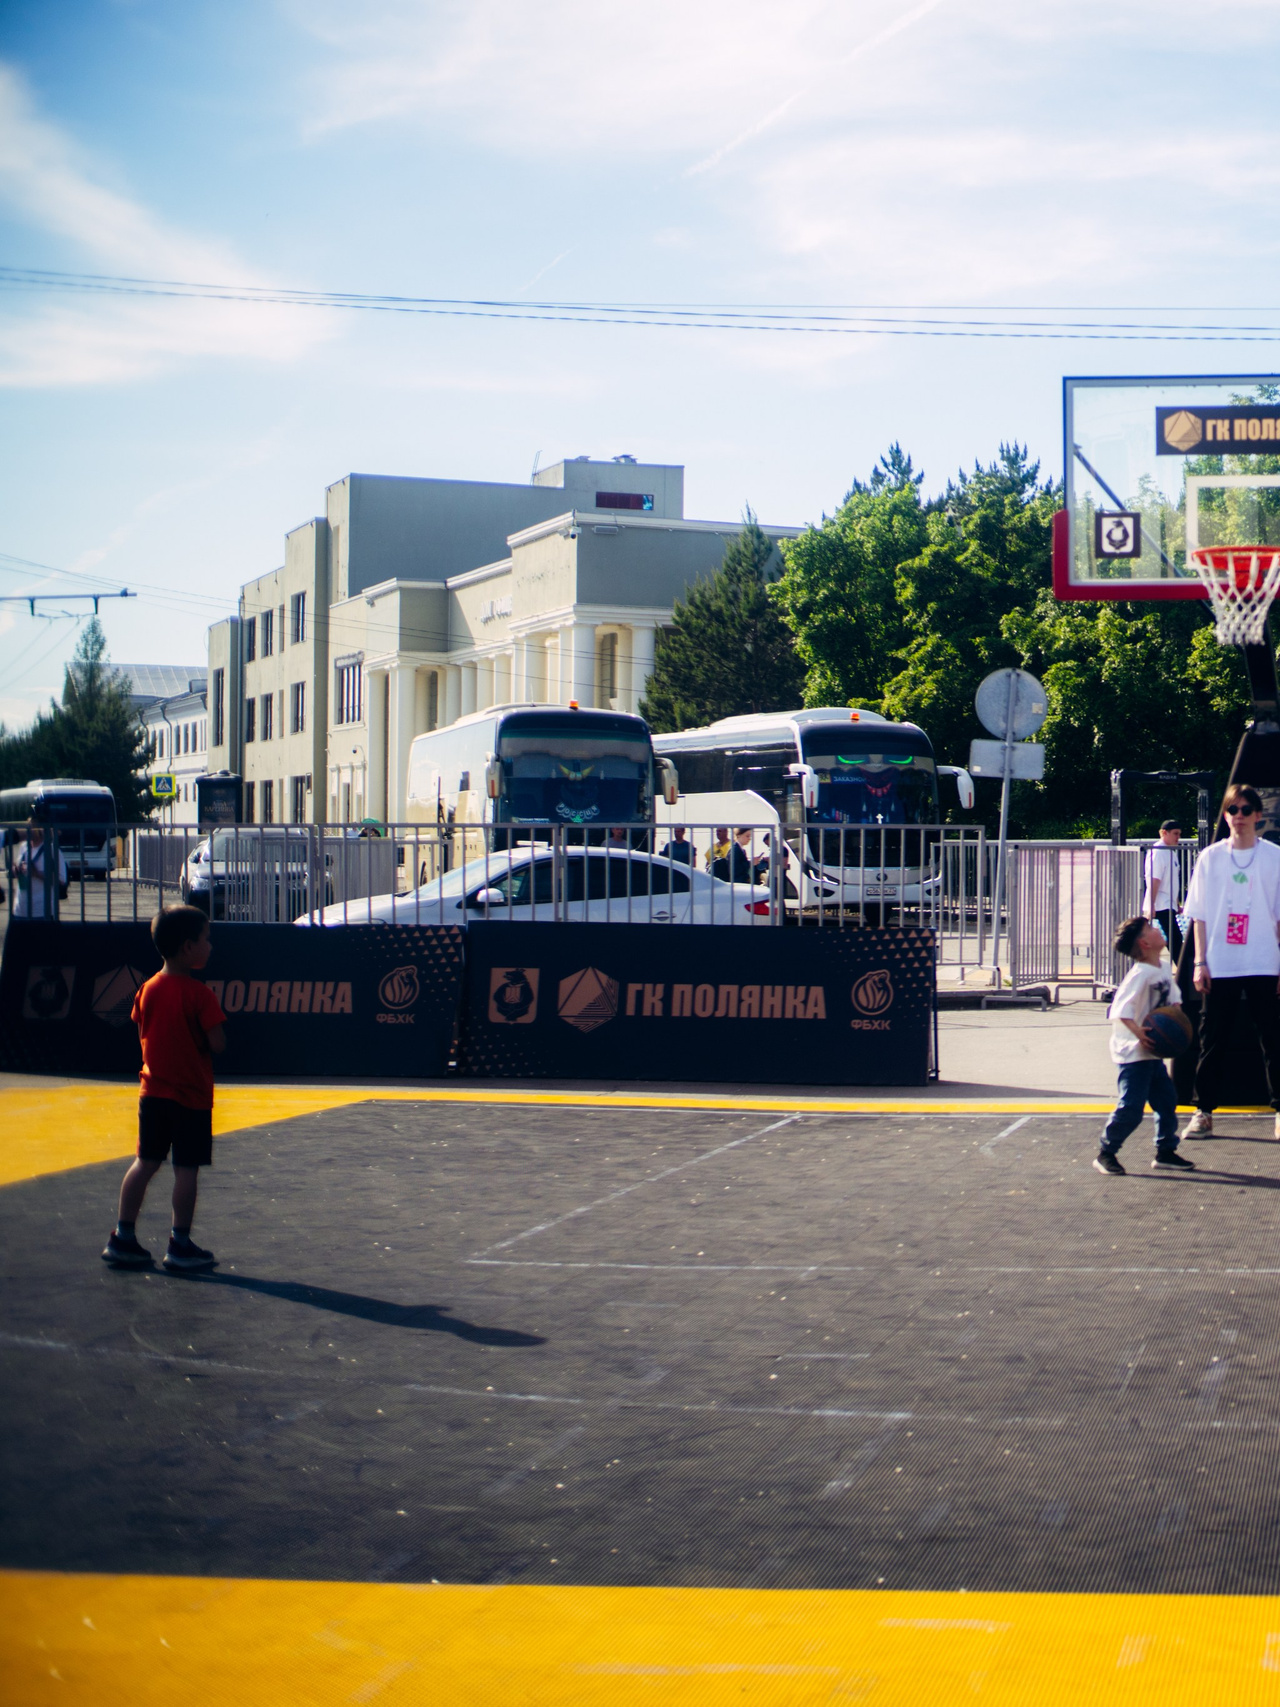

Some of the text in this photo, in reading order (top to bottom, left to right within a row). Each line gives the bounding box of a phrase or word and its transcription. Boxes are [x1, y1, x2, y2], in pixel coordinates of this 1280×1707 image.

[1205, 418, 1231, 442] ГК
[625, 982, 827, 1020] ГК ПОЛЯНКА
[375, 1013, 416, 1024] ФБХК
[850, 1019, 892, 1031] ФБХК
